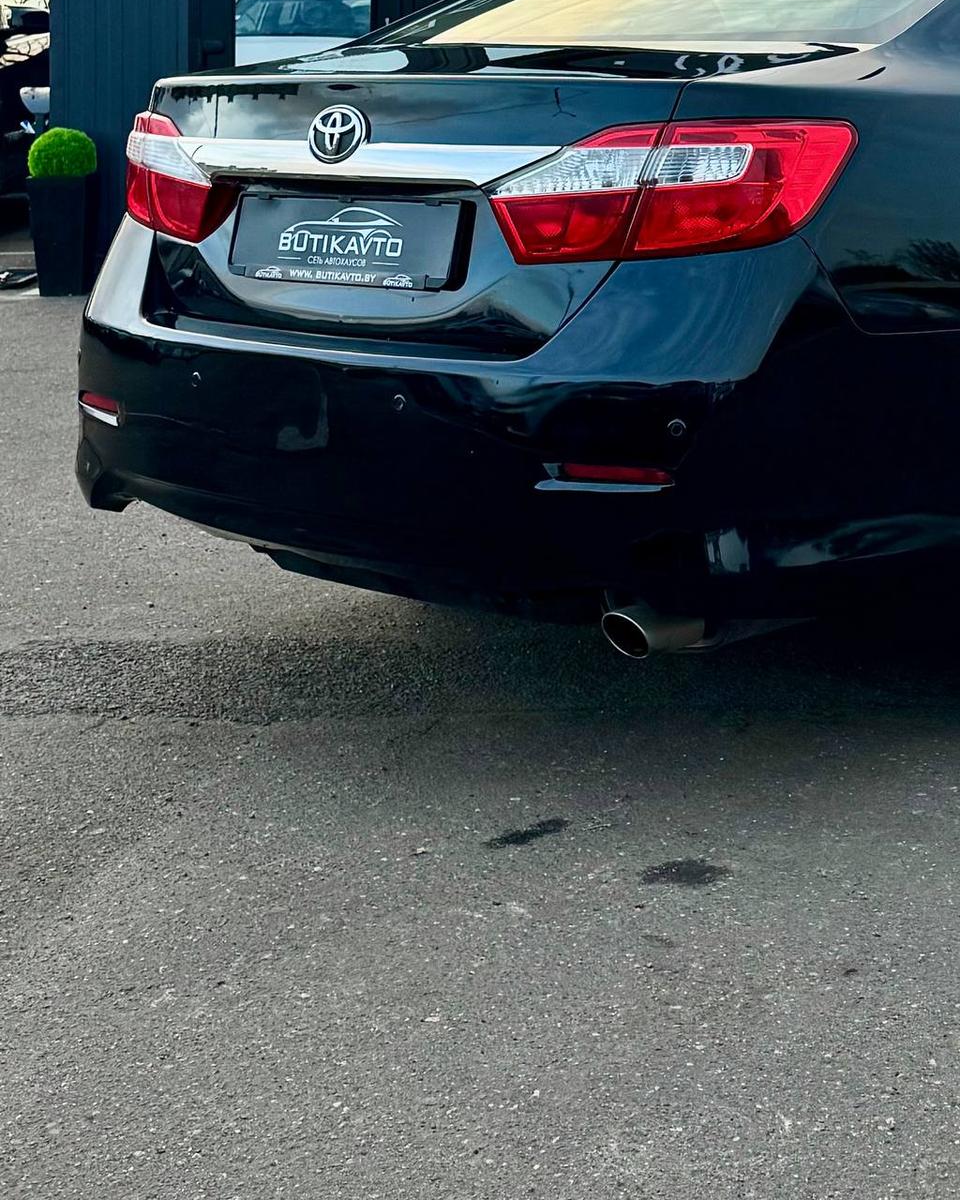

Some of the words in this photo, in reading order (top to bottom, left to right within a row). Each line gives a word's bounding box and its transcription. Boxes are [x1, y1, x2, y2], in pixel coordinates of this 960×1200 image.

[278, 232, 403, 256] BUTIKAVTO
[307, 255, 323, 265] СЕТЬ
[324, 256, 366, 267] АВТОХАУСОВ
[289, 269, 313, 279] WWW.
[315, 271, 376, 283] BUTIKAVTO.BY
